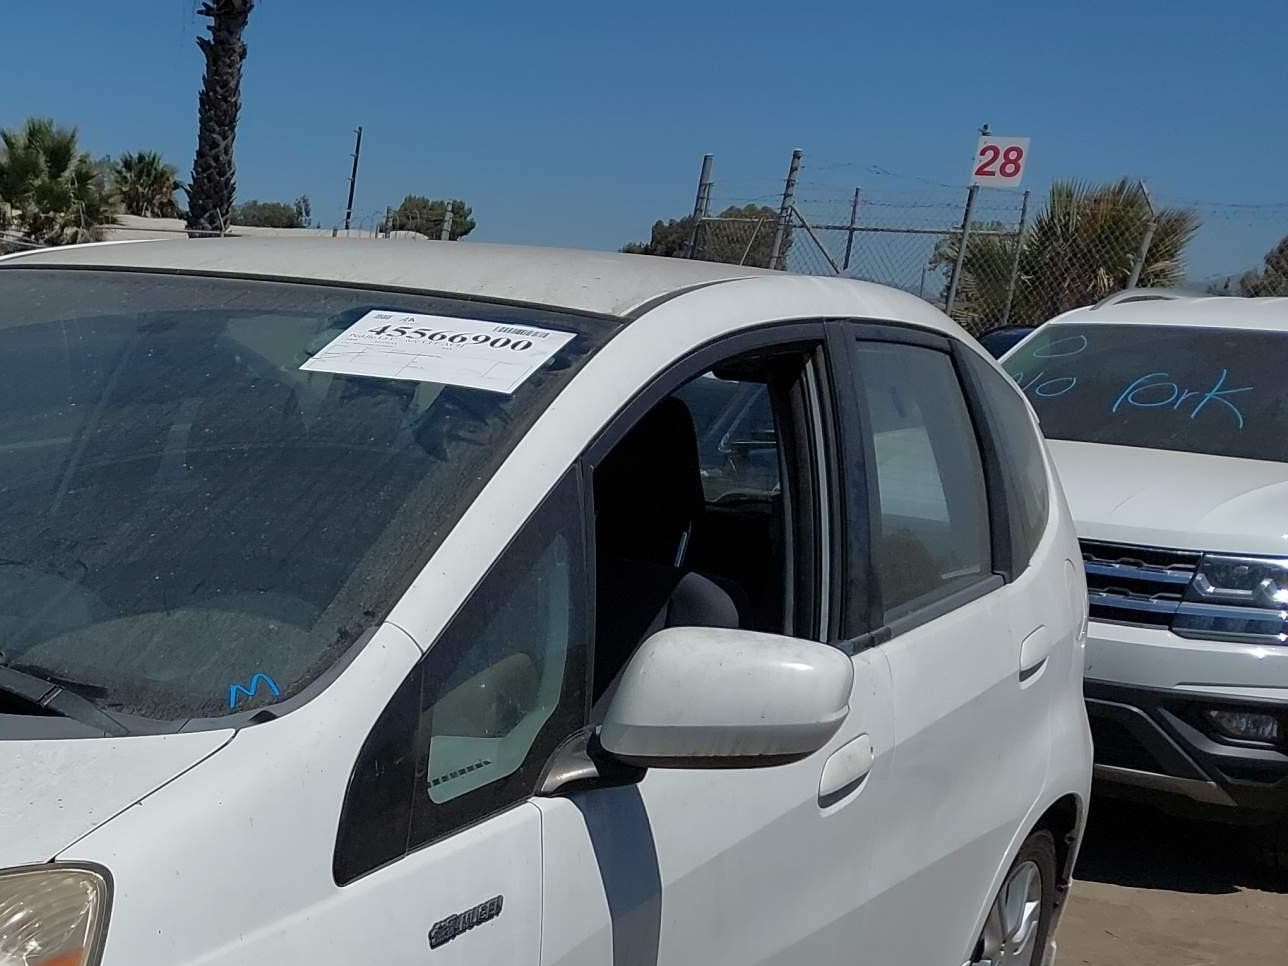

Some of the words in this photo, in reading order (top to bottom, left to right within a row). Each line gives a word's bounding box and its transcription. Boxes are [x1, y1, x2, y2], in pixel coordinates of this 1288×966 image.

[975, 145, 1023, 178] 28
[368, 323, 533, 352] 45566900
[229, 673, 280, 709] M
